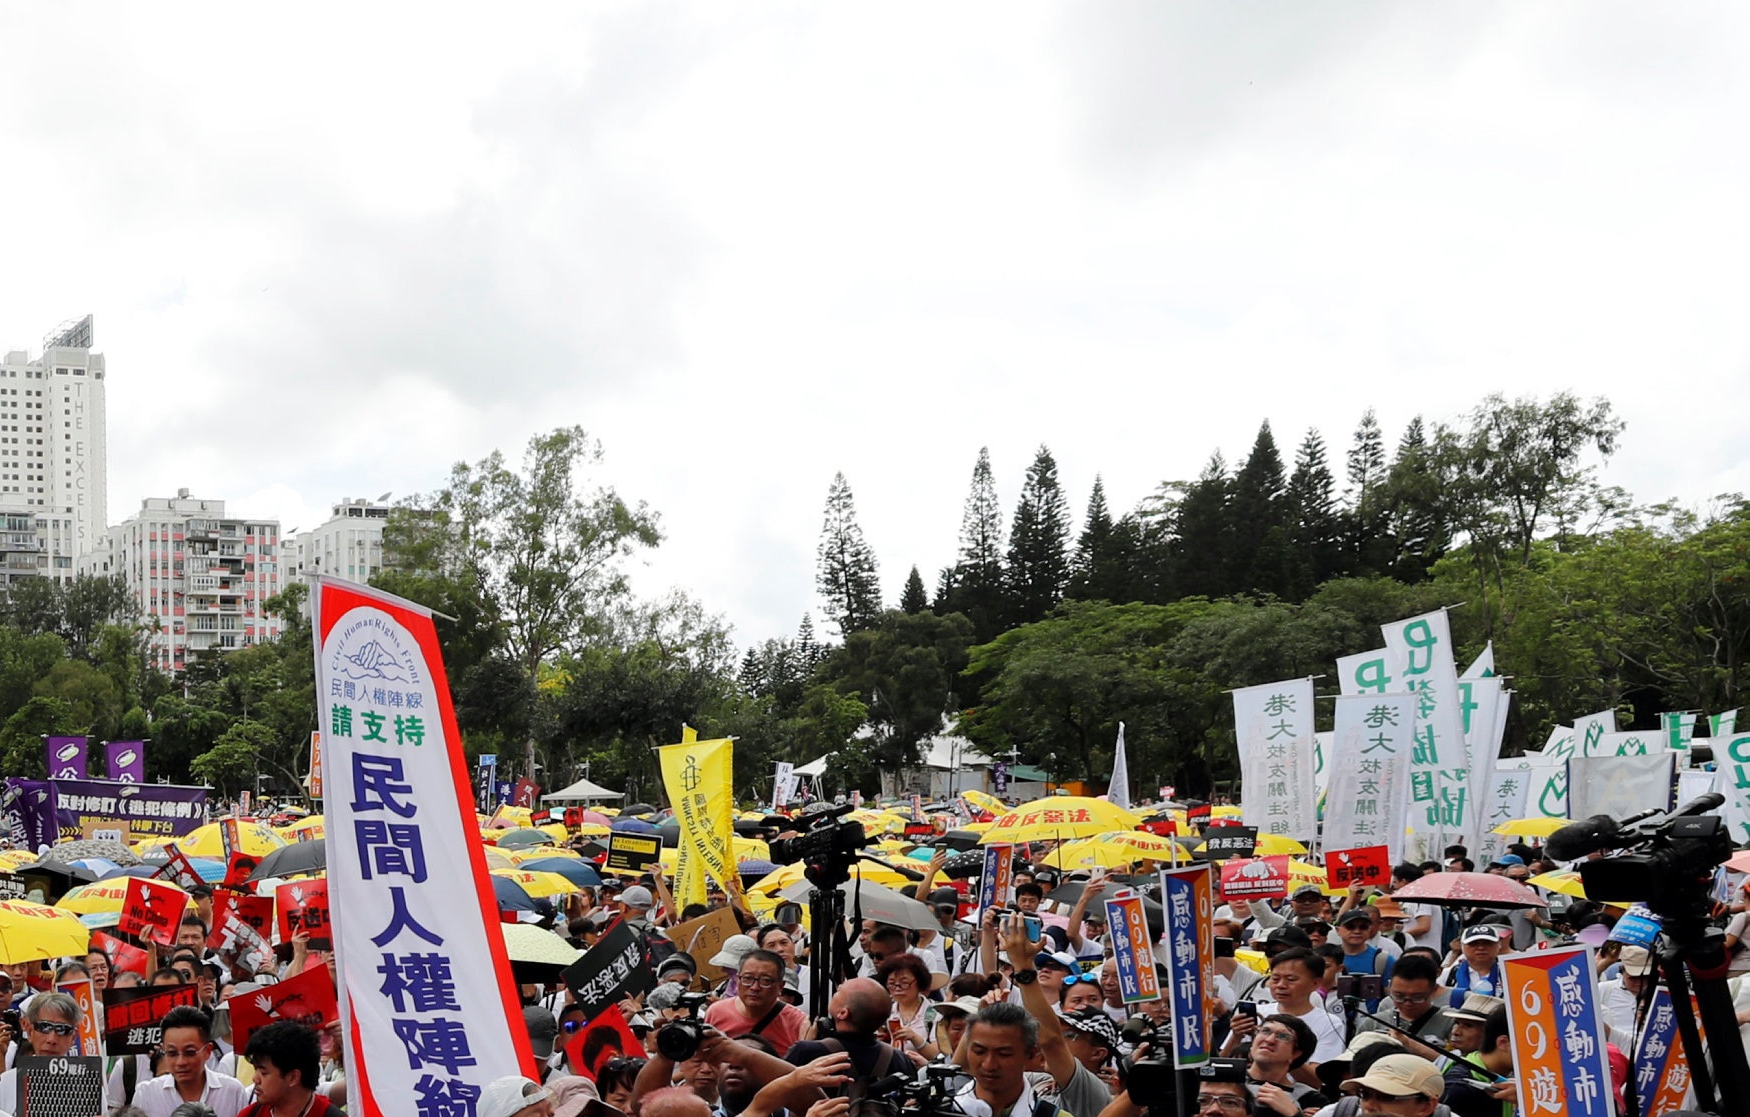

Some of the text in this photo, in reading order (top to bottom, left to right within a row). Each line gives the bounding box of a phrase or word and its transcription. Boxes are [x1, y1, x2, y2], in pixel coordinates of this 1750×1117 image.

[74, 382, 84, 430] THE
[345, 619, 374, 641] Human
[375, 618, 400, 648] Rights
[401, 650, 420, 685] Front
[331, 678, 424, 709] 民間人權陣線
[331, 703, 425, 746] 請支持
[131, 906, 144, 920] No
[145, 909, 169, 926] China
[1110, 906, 1137, 995] 感動市民
[1130, 908, 1154, 992] 69遊行
[1171, 884, 1200, 1050] 感動市民
